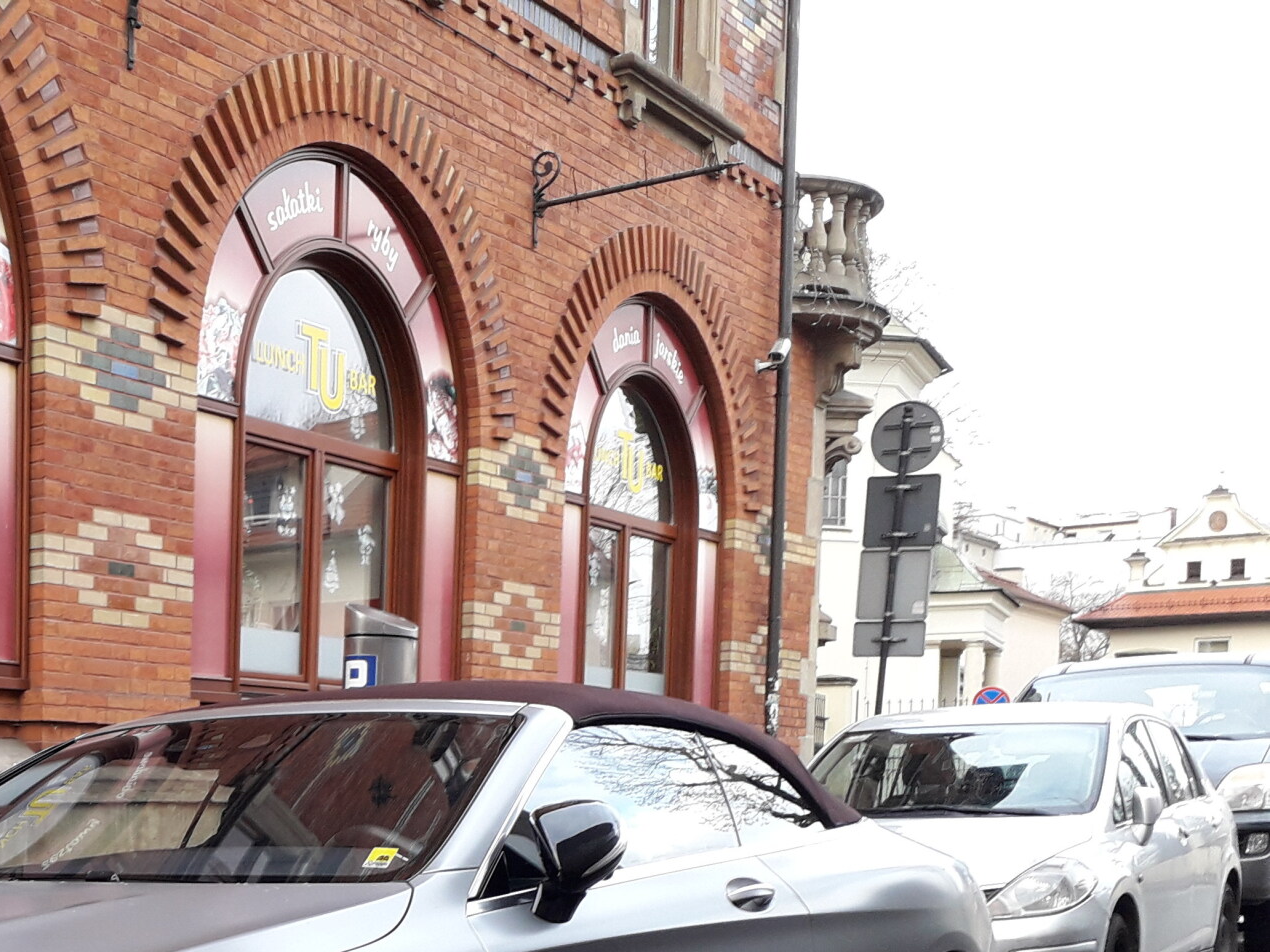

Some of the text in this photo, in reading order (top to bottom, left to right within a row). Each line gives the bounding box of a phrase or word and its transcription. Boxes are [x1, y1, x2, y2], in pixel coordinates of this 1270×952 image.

[267, 181, 324, 231] sałatki
[367, 219, 399, 272] ryby
[613, 326, 641, 353] dania
[254, 322, 377, 412] LUNCH TU BAR
[617, 429, 646, 494] TU
[345, 660, 368, 689] P
